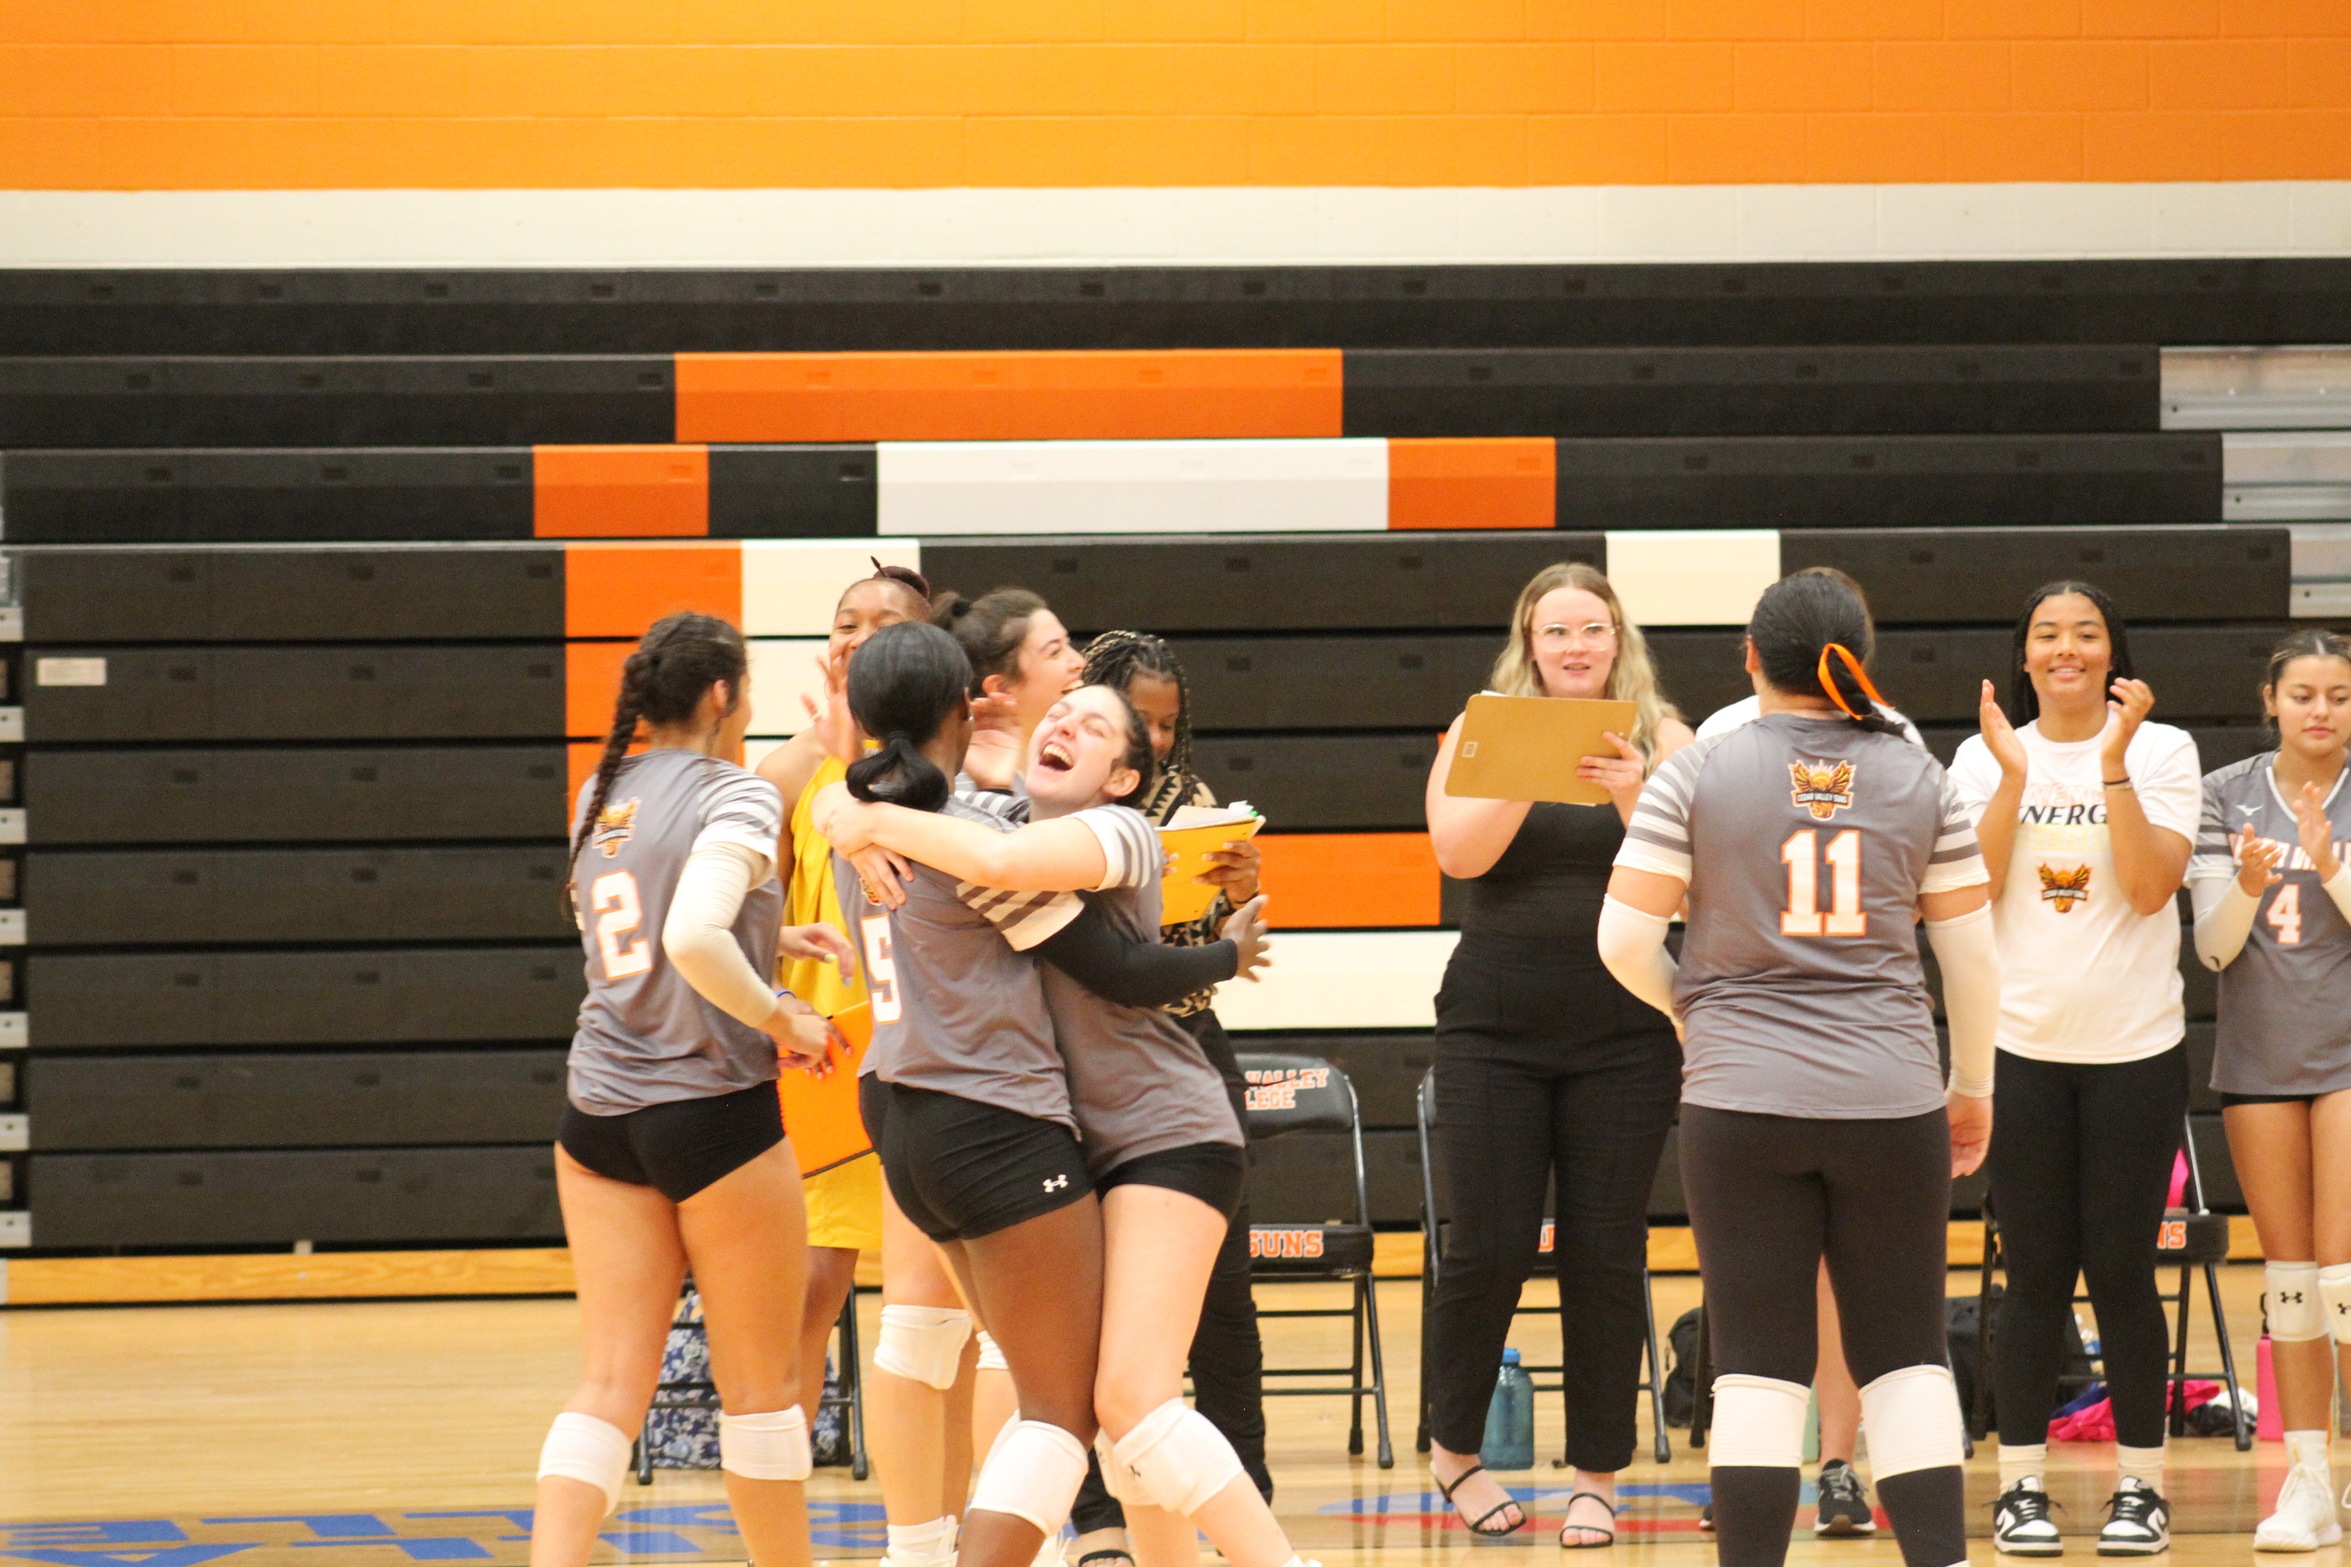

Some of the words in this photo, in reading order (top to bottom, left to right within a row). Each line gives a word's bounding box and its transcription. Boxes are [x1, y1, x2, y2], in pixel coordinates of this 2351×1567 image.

[2019, 803, 2107, 825] NERG
[1780, 829, 1867, 936] 11
[591, 869, 652, 981] 2
[2266, 884, 2302, 944] 4
[860, 912, 902, 1025] 5
[1244, 1068, 1330, 1090] VALLEY
[1249, 1230, 1324, 1257] SUNS
